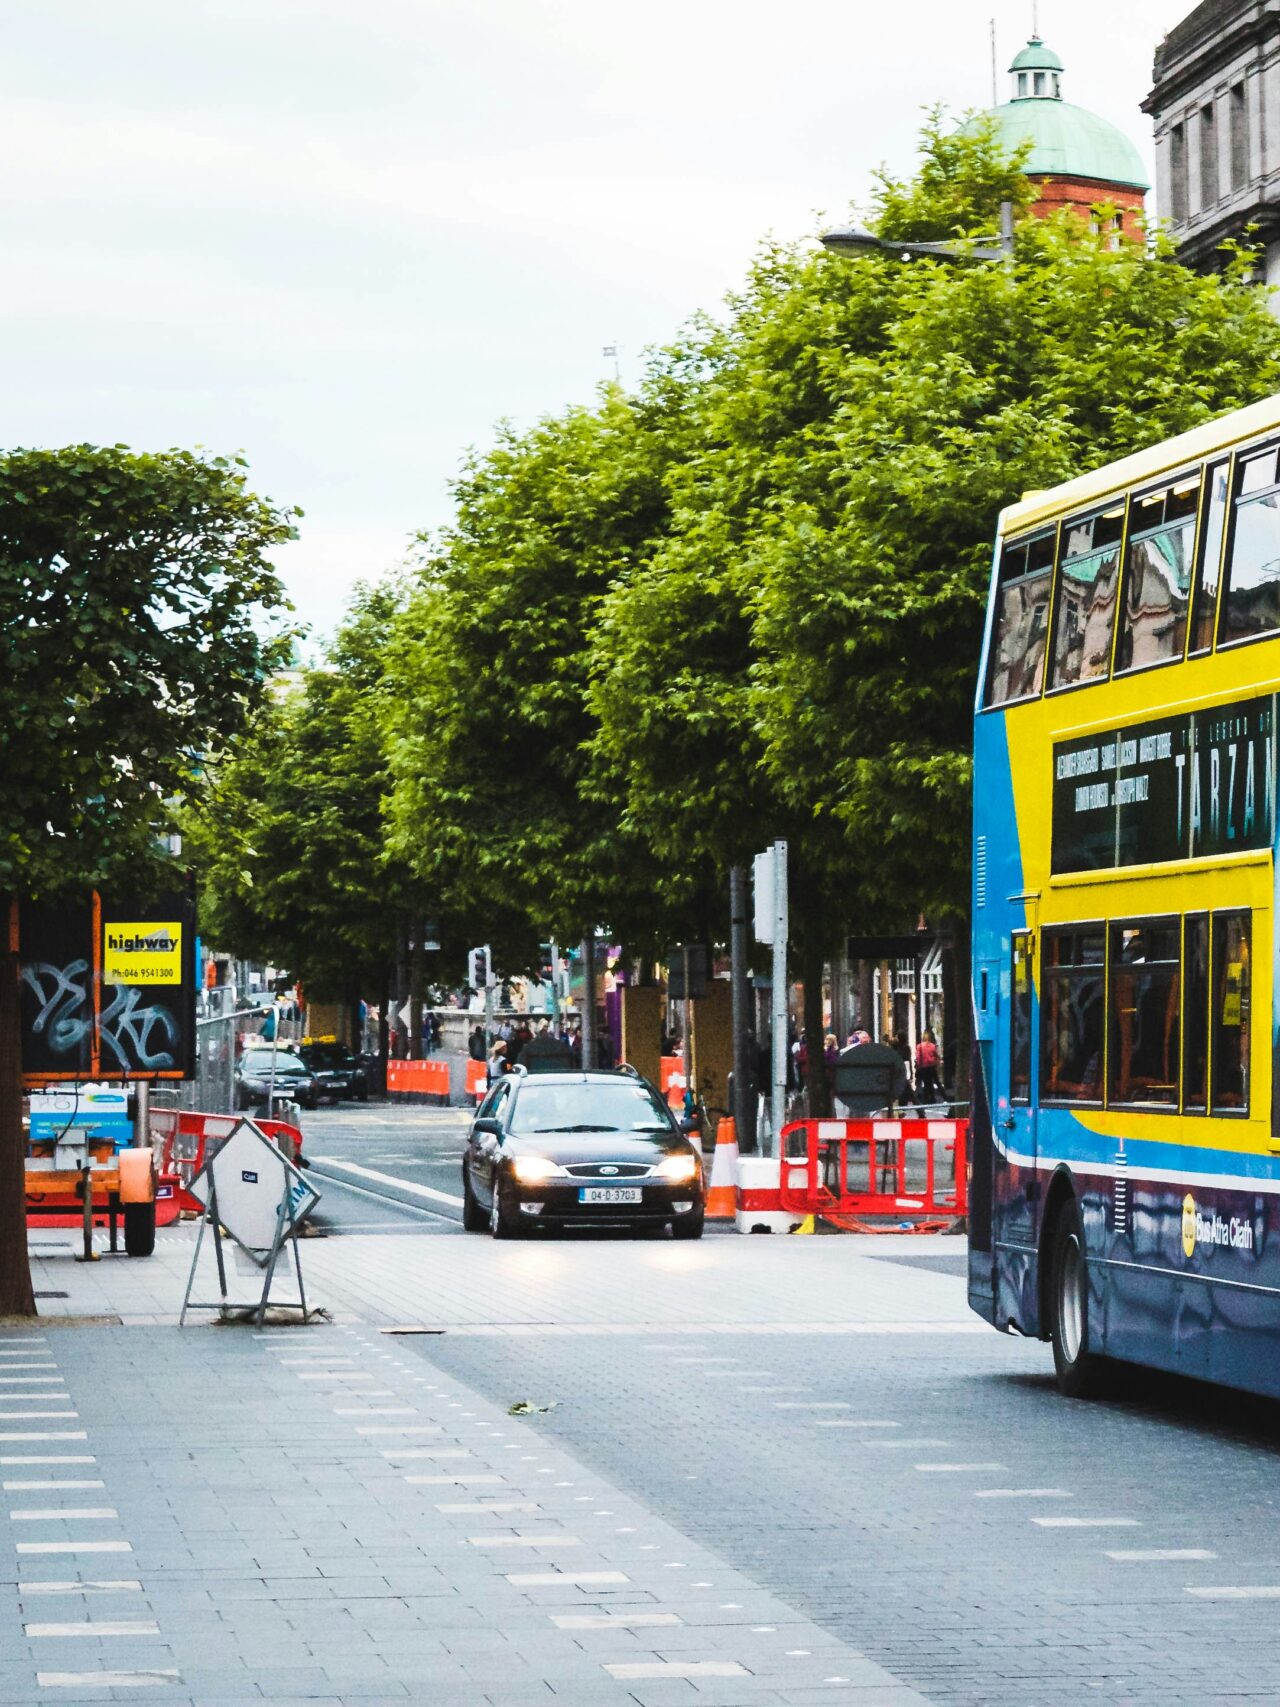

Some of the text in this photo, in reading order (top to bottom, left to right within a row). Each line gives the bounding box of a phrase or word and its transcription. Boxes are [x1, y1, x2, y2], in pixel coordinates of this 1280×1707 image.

[1175, 736, 1272, 845] TARZAN
[108, 934, 178, 952] highway
[141, 968, 174, 978] 9541300
[1196, 1212, 1211, 1243] Bus
[1229, 1216, 1253, 1249] Cliath
